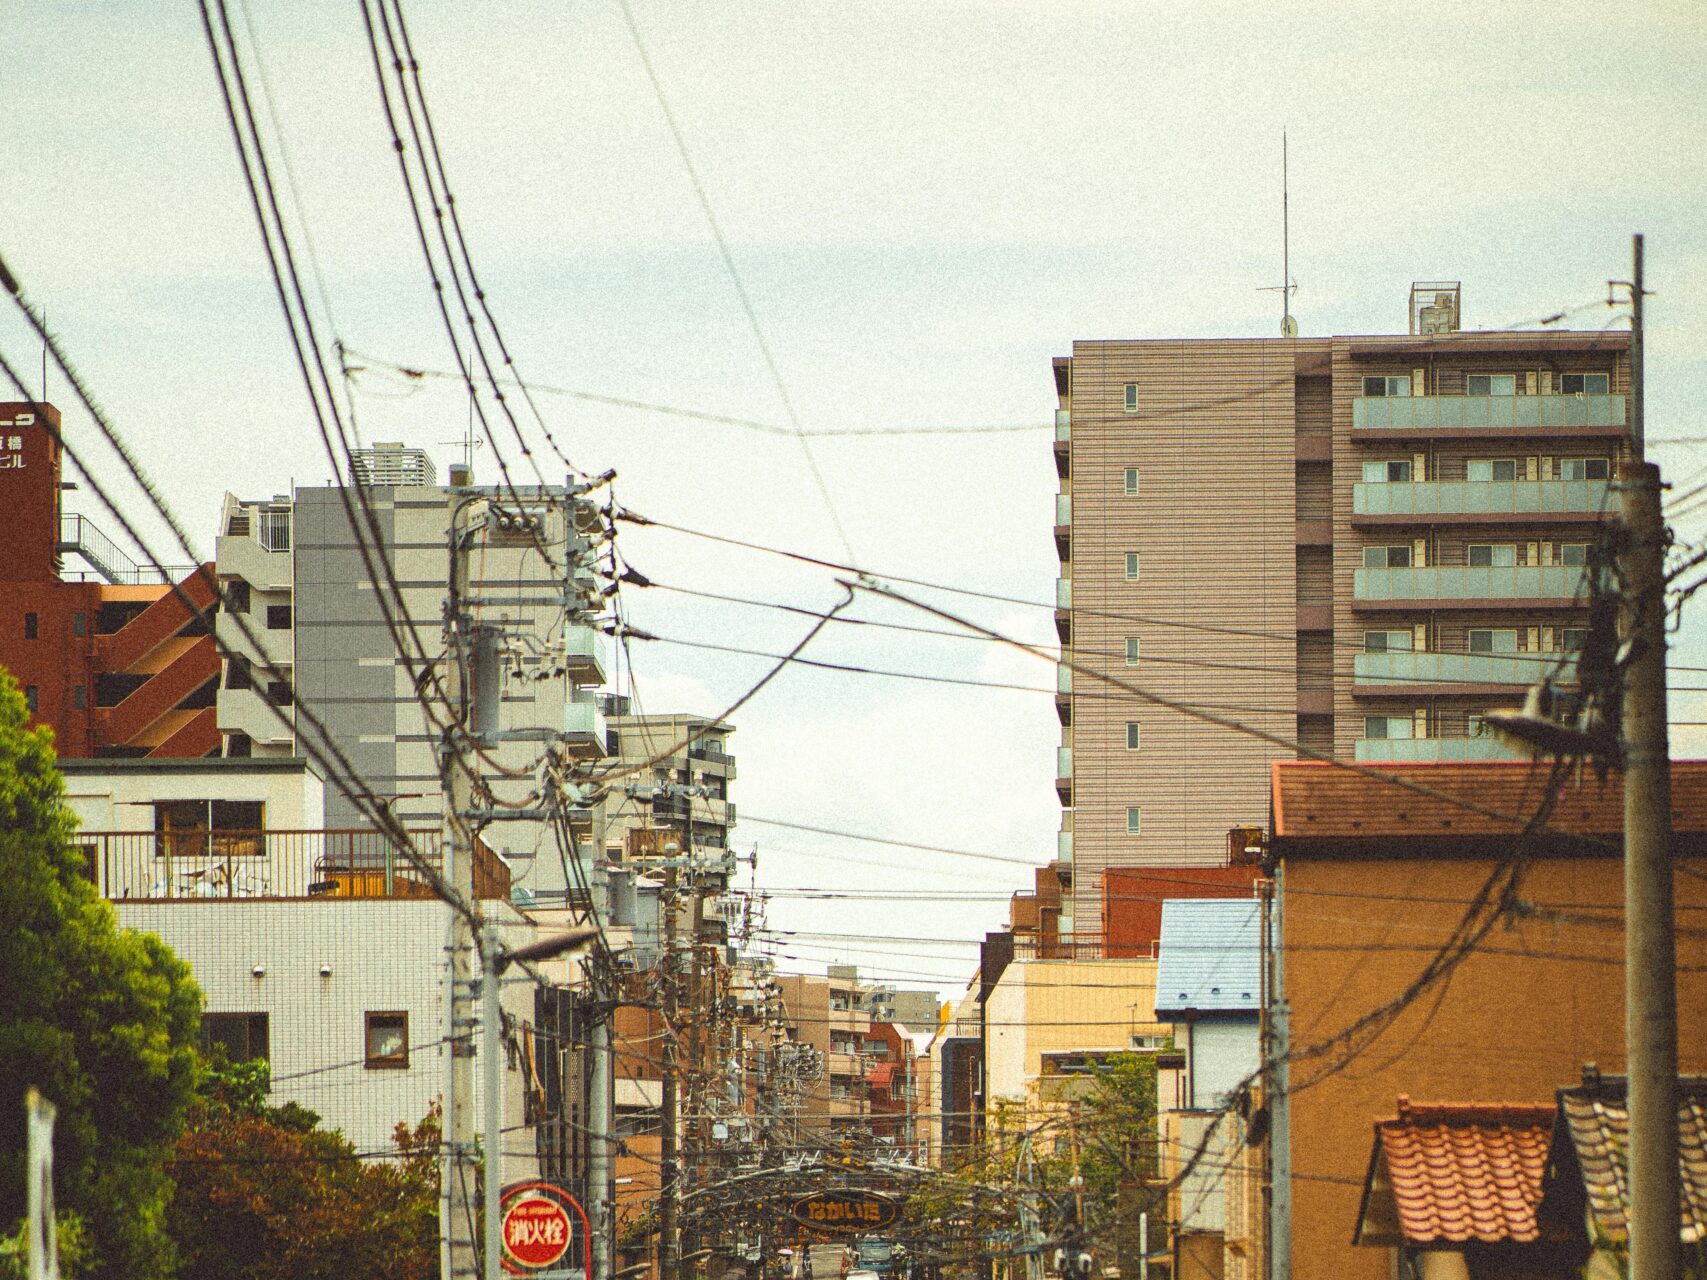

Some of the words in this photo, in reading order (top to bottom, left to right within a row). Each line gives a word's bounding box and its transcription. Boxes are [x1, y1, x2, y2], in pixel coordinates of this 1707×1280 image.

[808, 1201, 881, 1220] なかいた
[509, 1217, 565, 1246] 消火栓
